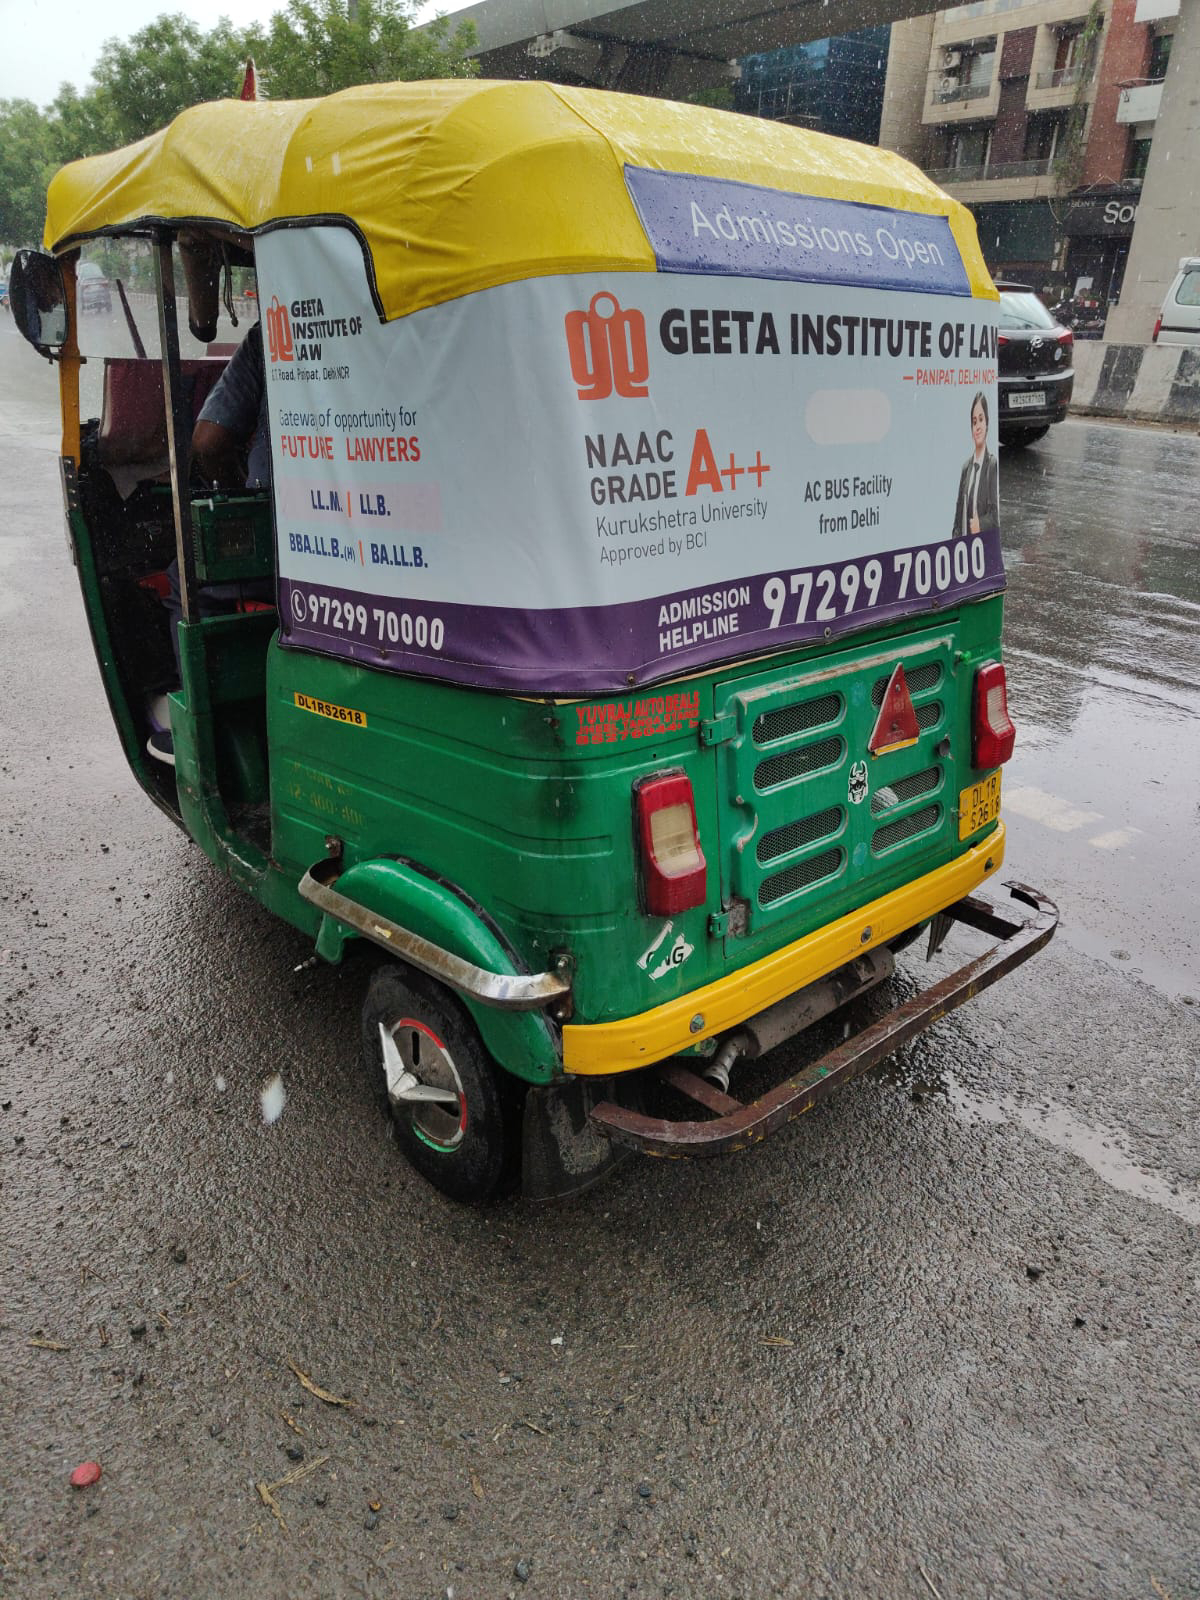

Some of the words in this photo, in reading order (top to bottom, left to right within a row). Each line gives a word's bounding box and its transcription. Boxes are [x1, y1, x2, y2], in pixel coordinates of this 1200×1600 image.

[1103, 201, 1138, 224] So
[690, 201, 872, 257] Admissions
[876, 228, 944, 268] Open
[291, 298, 324, 318] GEETA
[292, 319, 348, 340] INSTITUTE
[350, 316, 362, 335] OF
[659, 308, 780, 355] GEETA
[791, 314, 931, 357] INSTITUTE
[938, 322, 965, 359] OF
[295, 344, 322, 361] LAW
[916, 368, 956, 386] PANIPAT,
[958, 368, 980, 385] DELHI
[319, 408, 331, 427] of
[334, 410, 396, 432] opportunity
[399, 406, 417, 426] for
[281, 435, 334, 460] FUTURE
[346, 436, 421, 462] LAWYERS
[584, 429, 674, 468] NAAC
[685, 429, 770, 496] A++
[590, 470, 677, 505] GRADE
[804, 481, 821, 502] AC
[825, 477, 849, 499] BUS
[853, 474, 892, 498] Facility
[311, 490, 343, 512] LL.M.
[359, 493, 391, 516] LL.B.
[597, 506, 697, 537] Kurukshetra
[701, 497, 768, 523] University
[819, 512, 847, 534] from
[851, 506, 880, 529] Delhi
[371, 543, 428, 568] BA.LL.B.
[600, 540, 664, 566] Approved
[669, 536, 682, 557] by
[686, 532, 707, 549] BCI
[762, 559, 883, 629] 97299
[893, 536, 986, 599] 70000
[658, 586, 750, 627] ADMISSION
[308, 594, 367, 635] 97299
[373, 608, 444, 651] 70000
[659, 612, 739, 653] HELPLINE
[298, 695, 362, 724] DL1RS2618
[576, 702, 633, 725] YUVRAJ
[634, 698, 665, 716] AUTO
